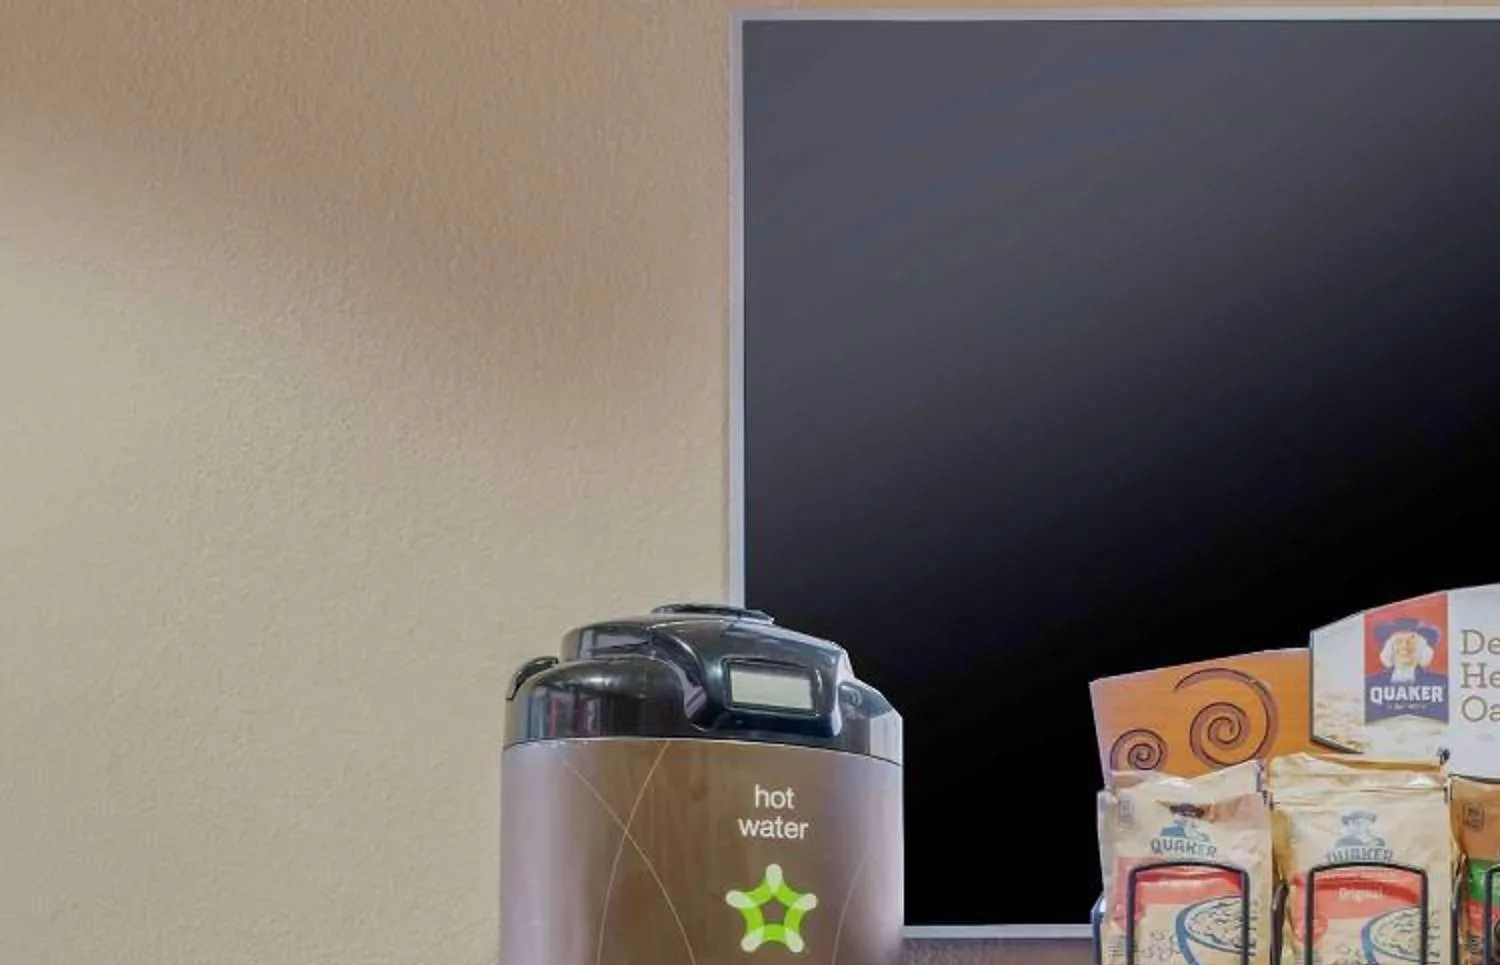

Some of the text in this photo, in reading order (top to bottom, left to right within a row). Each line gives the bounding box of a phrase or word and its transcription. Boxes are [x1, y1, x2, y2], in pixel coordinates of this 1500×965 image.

[1369, 685, 1444, 704] QUAKER
[754, 784, 795, 811] hot
[738, 817, 809, 840] water
[1150, 837, 1218, 858] QUAKER
[1326, 846, 1394, 863] QUAKER
